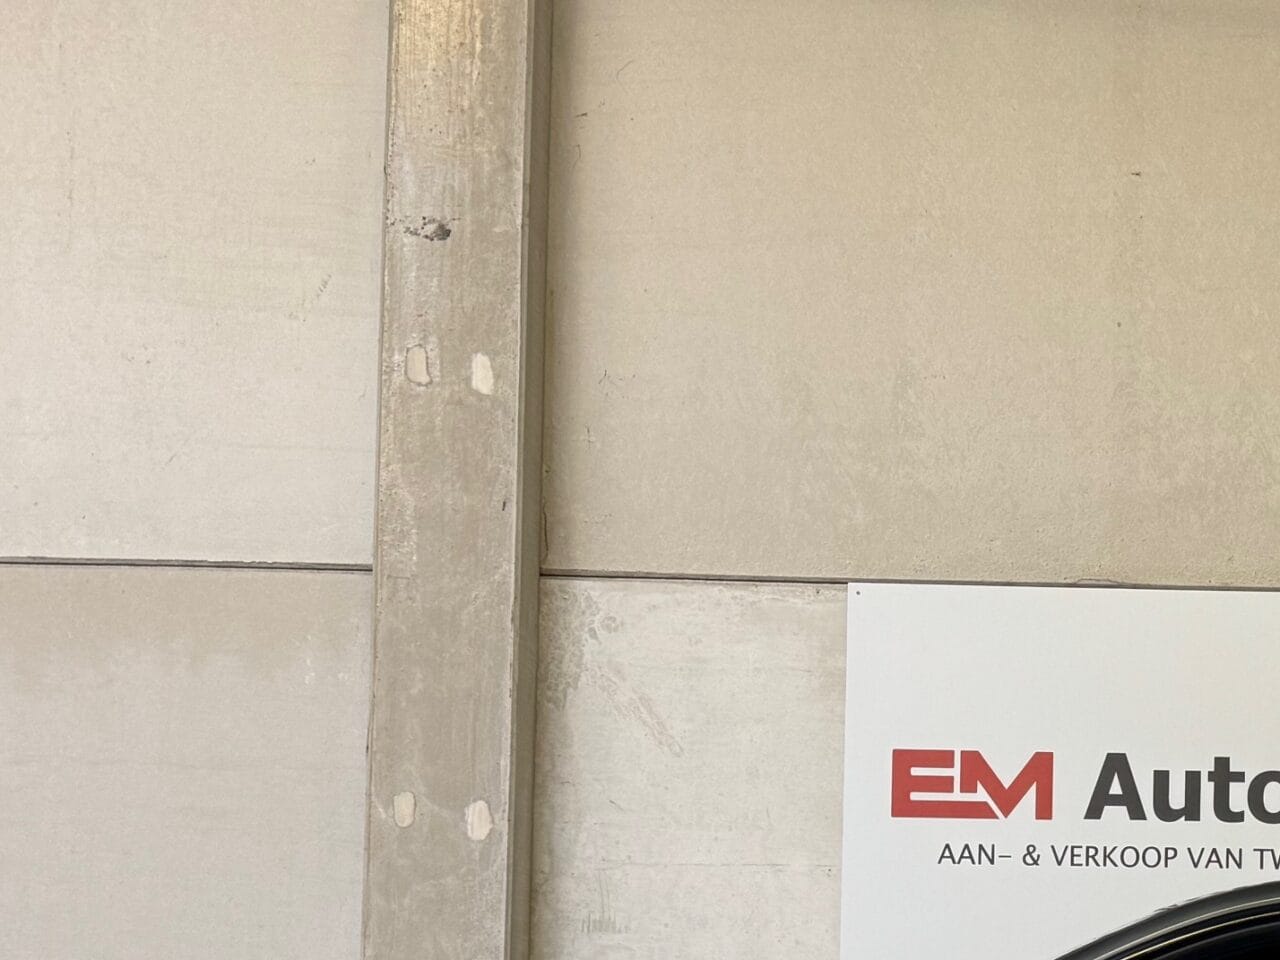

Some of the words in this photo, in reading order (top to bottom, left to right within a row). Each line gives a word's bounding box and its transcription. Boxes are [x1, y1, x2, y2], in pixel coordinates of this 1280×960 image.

[891, 748, 1055, 821] EM
[1021, 843, 1042, 867] &
[1050, 844, 1179, 869] VERKOOP
[1186, 847, 1244, 870] VAN
